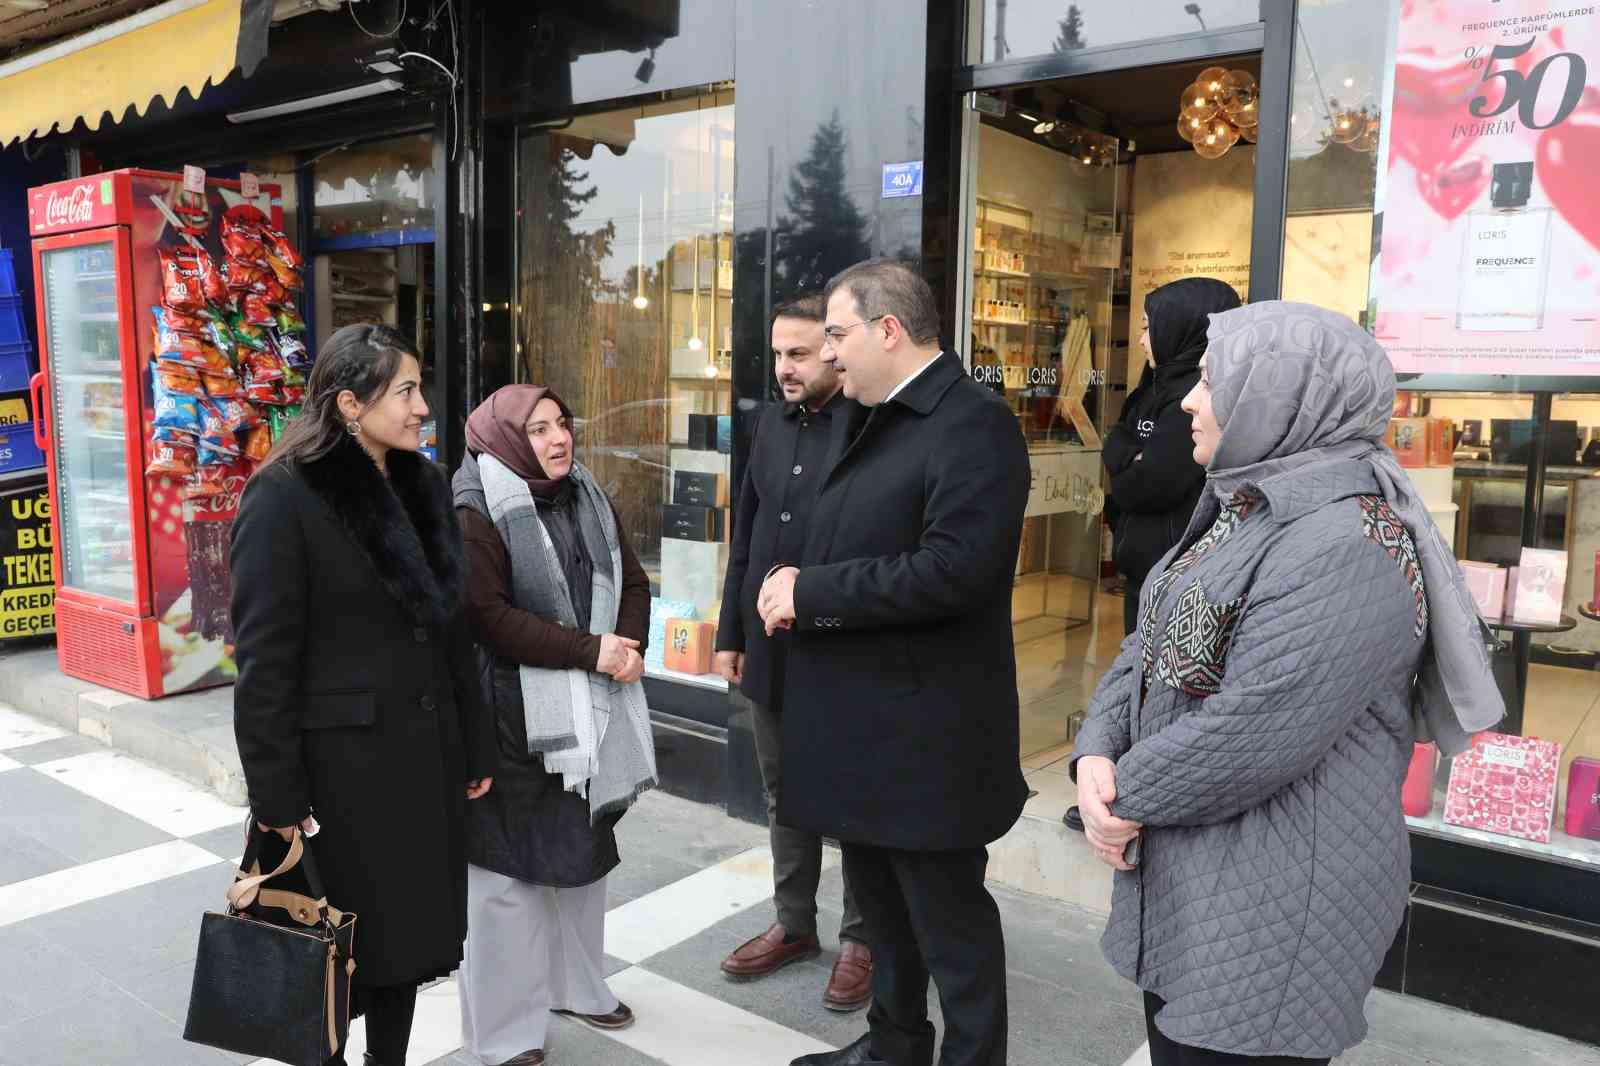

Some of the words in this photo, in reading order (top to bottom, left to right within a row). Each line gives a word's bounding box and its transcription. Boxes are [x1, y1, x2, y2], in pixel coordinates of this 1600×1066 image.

[1462, 17, 1519, 32] FREQUENCE
[1521, 7, 1595, 23] PARFÜMLERDE
[1513, 23, 1548, 36] ÜRÜNE
[891, 173, 912, 186] 40A
[1475, 257, 1536, 267] FREQUENCE
[970, 364, 1002, 384] ORIS
[1026, 367, 1057, 385] LORIS
